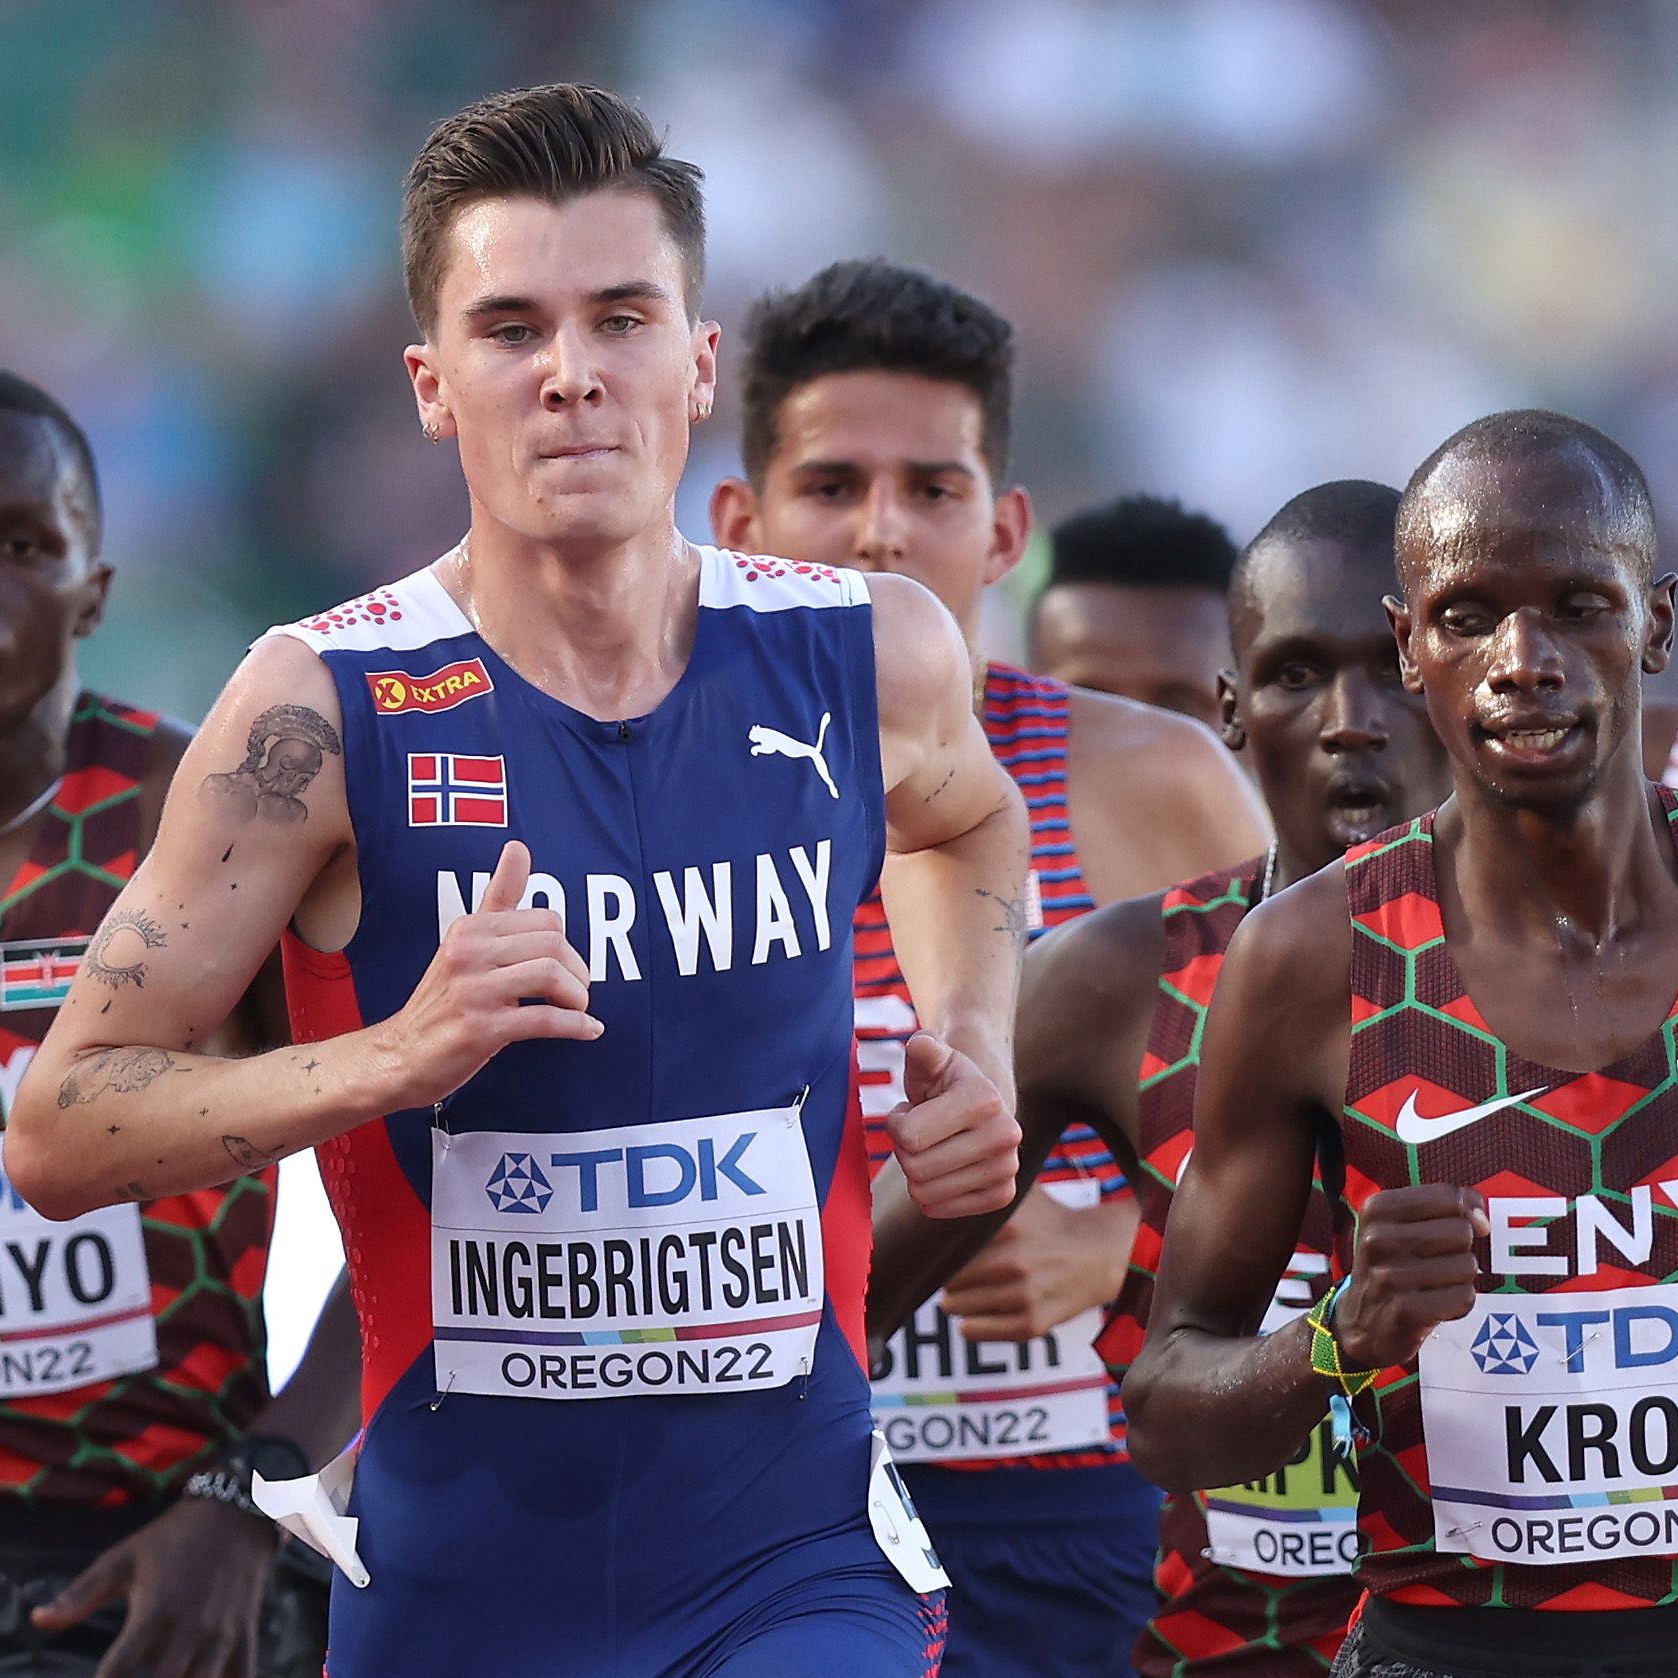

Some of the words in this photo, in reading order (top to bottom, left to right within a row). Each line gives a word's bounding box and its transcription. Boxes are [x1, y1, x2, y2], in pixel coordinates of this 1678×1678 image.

[409, 671, 482, 703] EXTRA
[550, 1131, 768, 1213] TDK
[448, 1218, 810, 1319] INGEBRIGTSEN
[500, 1342, 775, 1390] OREGON22
[877, 1407, 1048, 1451] GON22
